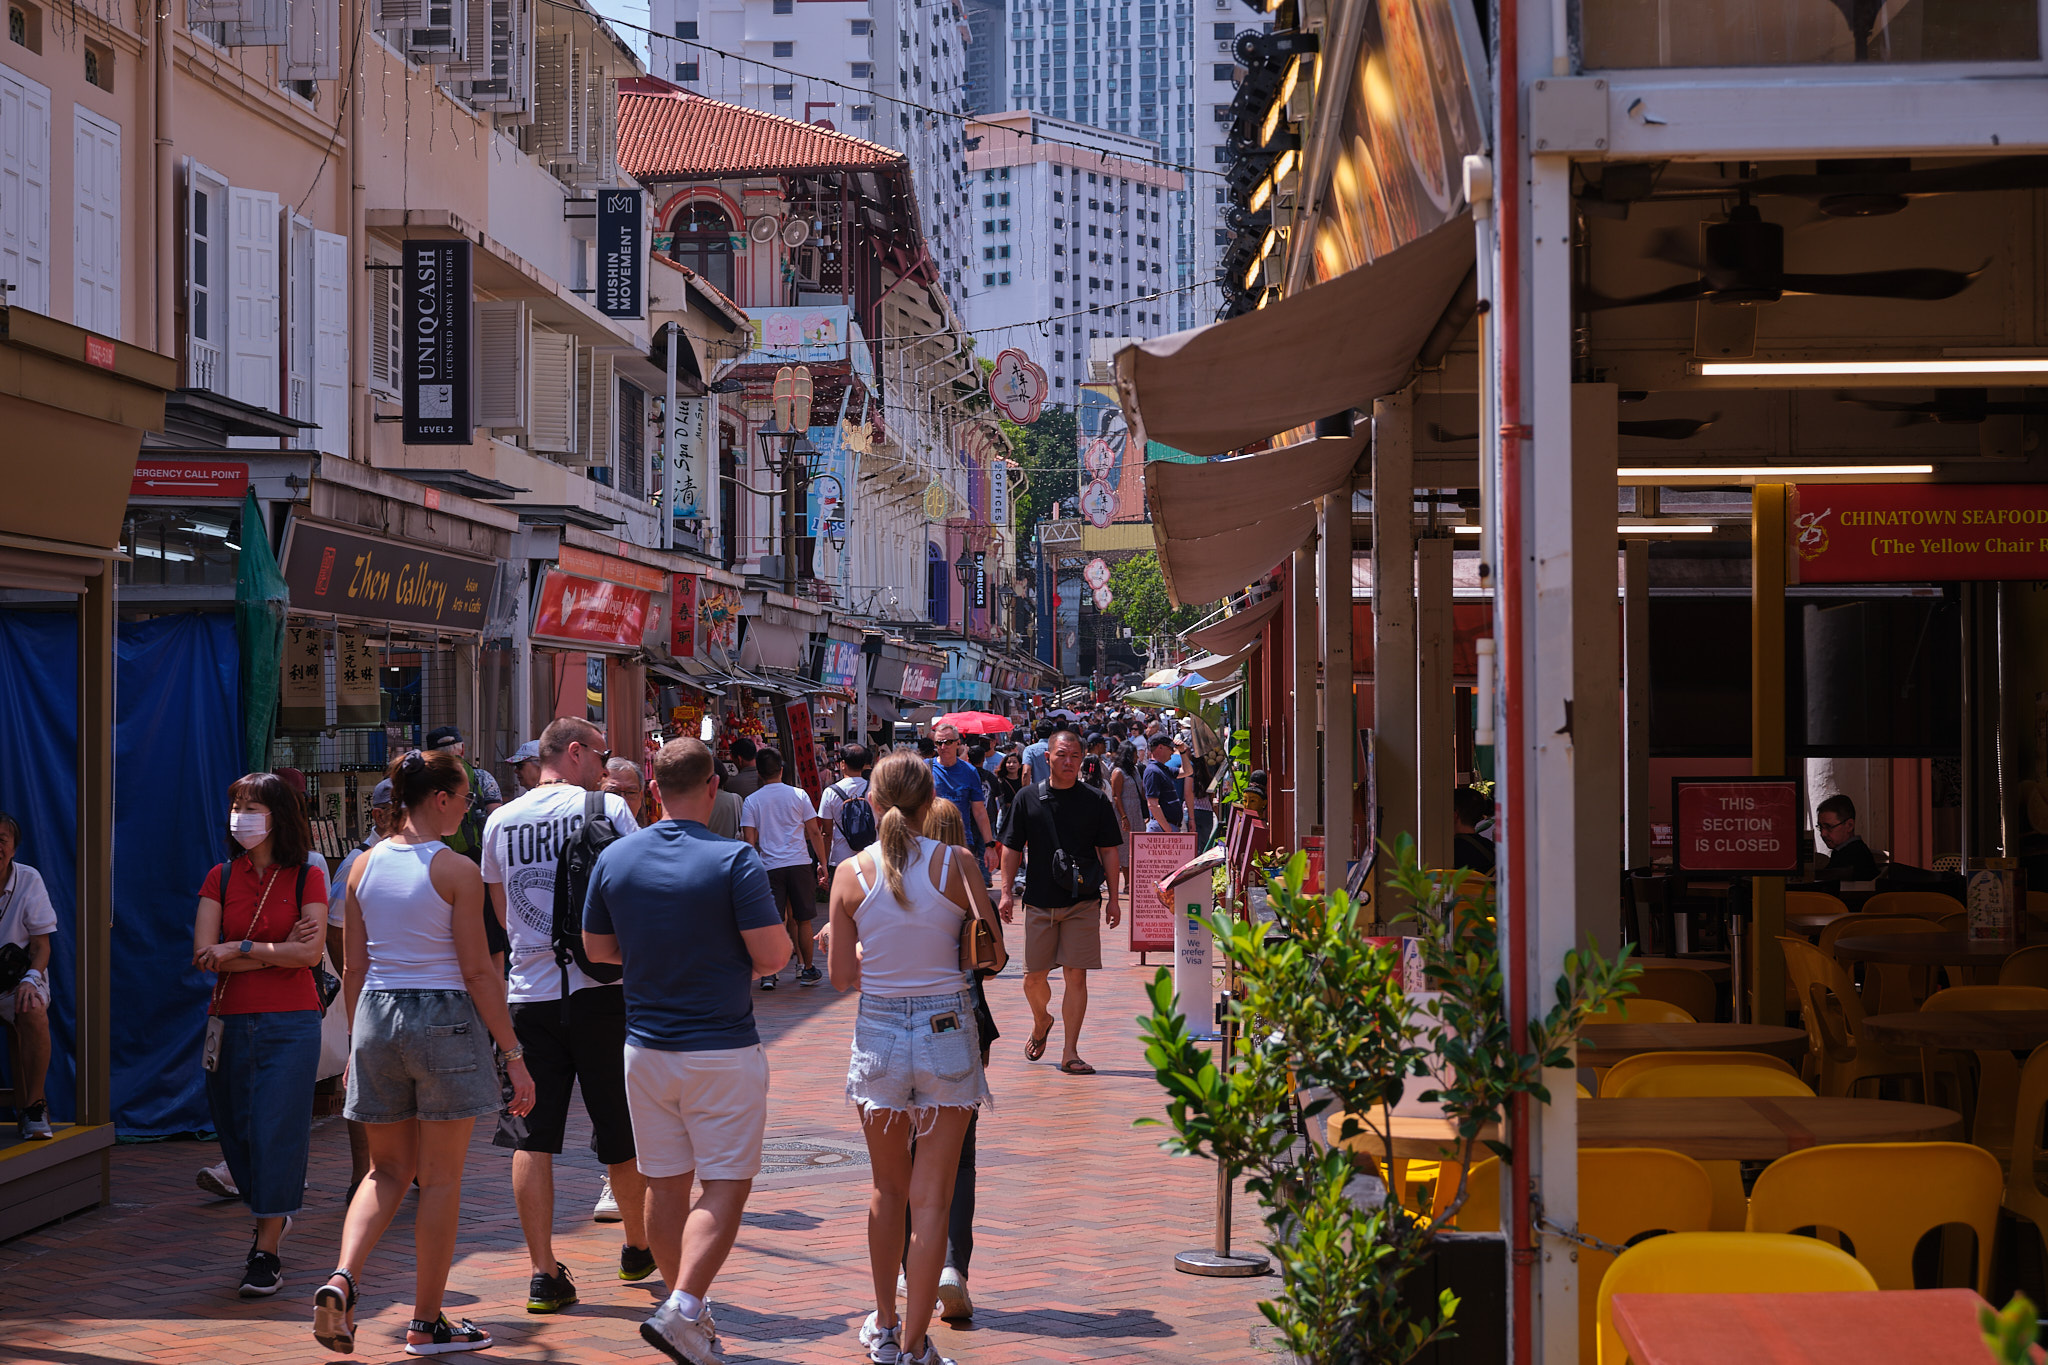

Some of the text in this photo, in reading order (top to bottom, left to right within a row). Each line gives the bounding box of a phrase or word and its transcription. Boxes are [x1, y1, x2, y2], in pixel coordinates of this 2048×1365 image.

[620, 226, 632, 310] MOVEMENT
[607, 252, 619, 310] MUSHIN
[418, 249, 439, 381] UNIQCASH
[439, 387, 449, 404] UC
[695, 402, 705, 421] Spa
[674, 400, 694, 473] Spa D Lite
[184, 469, 209, 479] CALL
[211, 470, 241, 479] POINT
[673, 474, 698, 506] 清
[994, 473, 1002, 521] OFFICES
[1840, 509, 2048, 526] CHINATOWN SEAFOOD
[1871, 537, 1915, 556] (The
[1919, 537, 1979, 553] Yellow
[1984, 537, 2034, 553] Chair
[347, 550, 391, 601] Zhen
[395, 560, 448, 621] Gallery
[464, 577, 479, 593] Asian
[976, 555, 984, 605] STARBUCKS
[452, 596, 463, 612] Arts
[468, 597, 482, 614] Crafts
[1719, 797, 1755, 810] THIS
[1702, 818, 1772, 831] SECTION
[1695, 839, 1780, 852] IS CLOSED
[1181, 948, 1205, 957] prefer
[1187, 939, 1201, 948] We
[1185, 956, 1202, 965] Visa
